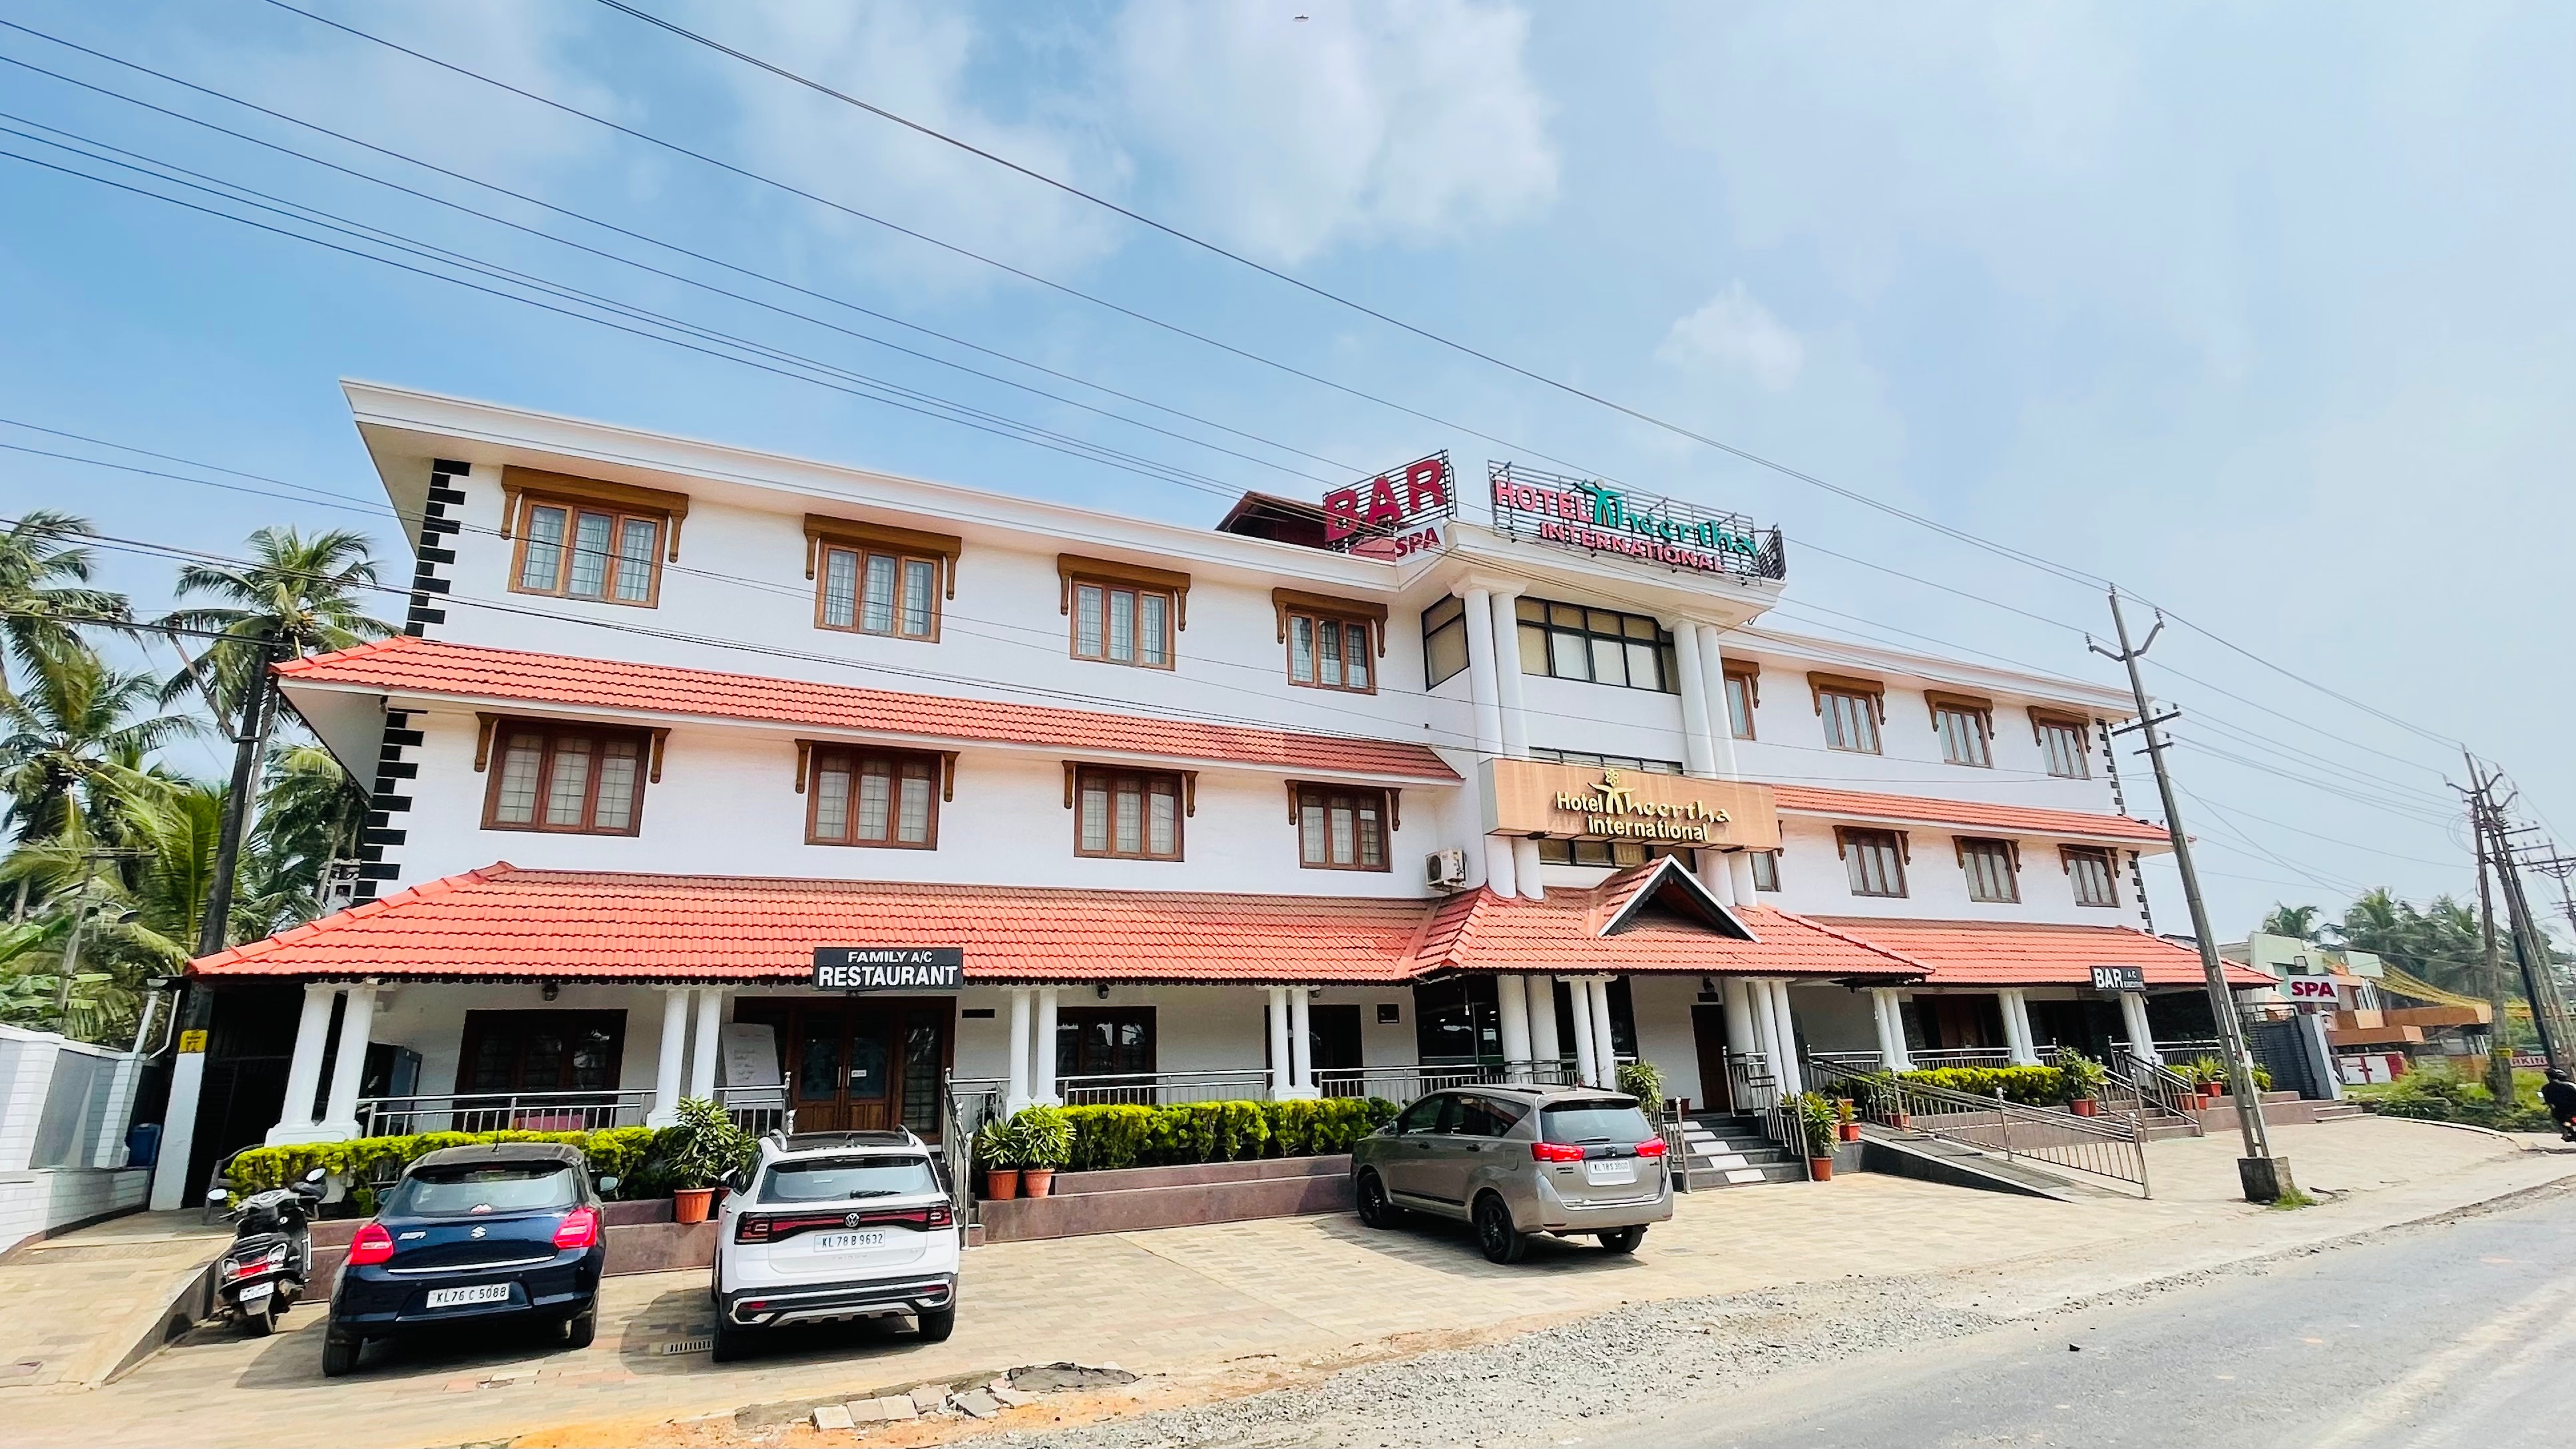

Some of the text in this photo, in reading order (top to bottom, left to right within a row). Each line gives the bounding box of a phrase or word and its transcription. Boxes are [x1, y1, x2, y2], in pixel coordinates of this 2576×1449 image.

[1325, 459, 1447, 542] BAR
[1494, 479, 1592, 522] HOTEL
[1395, 527, 1440, 558] SPA
[1540, 522, 1725, 573] INTERNATIONAL
[1556, 791, 1603, 813] Hotel
[847, 950, 933, 962] FAMILY A/C
[818, 965, 958, 987] RESTAURANT
[2093, 968, 2123, 989] BAR
[2291, 981, 2336, 998] SPA
[859, 1233, 883, 1245] 9632
[479, 1287, 506, 1299] 5088
